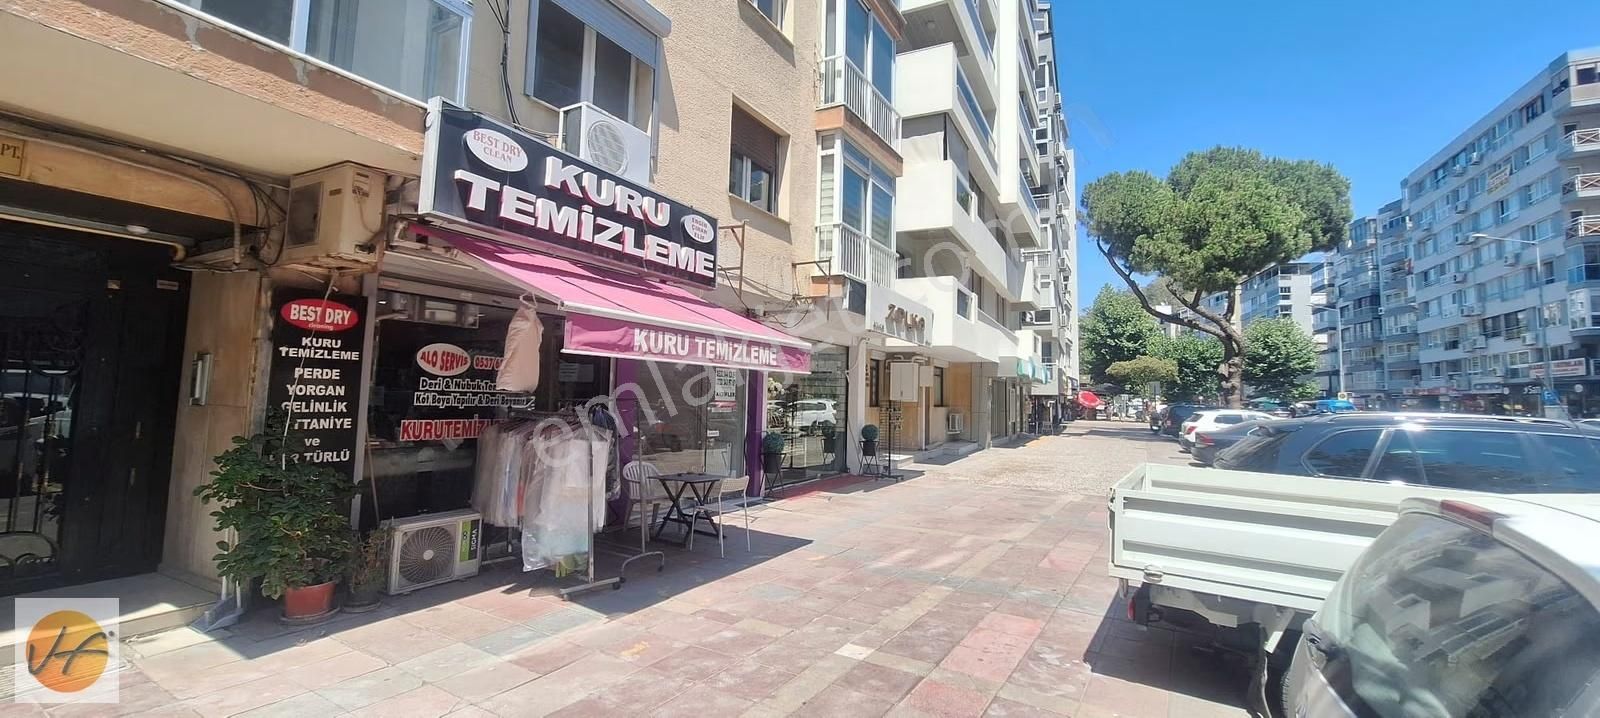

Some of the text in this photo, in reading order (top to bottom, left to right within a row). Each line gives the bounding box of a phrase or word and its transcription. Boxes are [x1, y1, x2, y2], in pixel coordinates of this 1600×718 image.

[473, 130, 522, 158] BEST DRY
[483, 146, 512, 163] CLEAN
[545, 155, 671, 228] KURU
[454, 169, 715, 278] TEMİZLEME
[290, 303, 351, 325] BEST DRY
[301, 336, 342, 348] KURU
[634, 328, 690, 356] KURU
[279, 346, 360, 361] TEMİZLEME
[420, 350, 438, 368] ALO
[294, 367, 341, 380] PERDE
[286, 384, 345, 396] YORGAN
[420, 377, 442, 391] Deri
[443, 378, 452, 391] &
[454, 379, 483, 391] Nubuk
[281, 400, 348, 412] GELİNLİK
[414, 392, 430, 405] Kot
[431, 393, 451, 408] Boya
[305, 437, 321, 447] ve
[303, 449, 350, 463] TÜRLÜ
